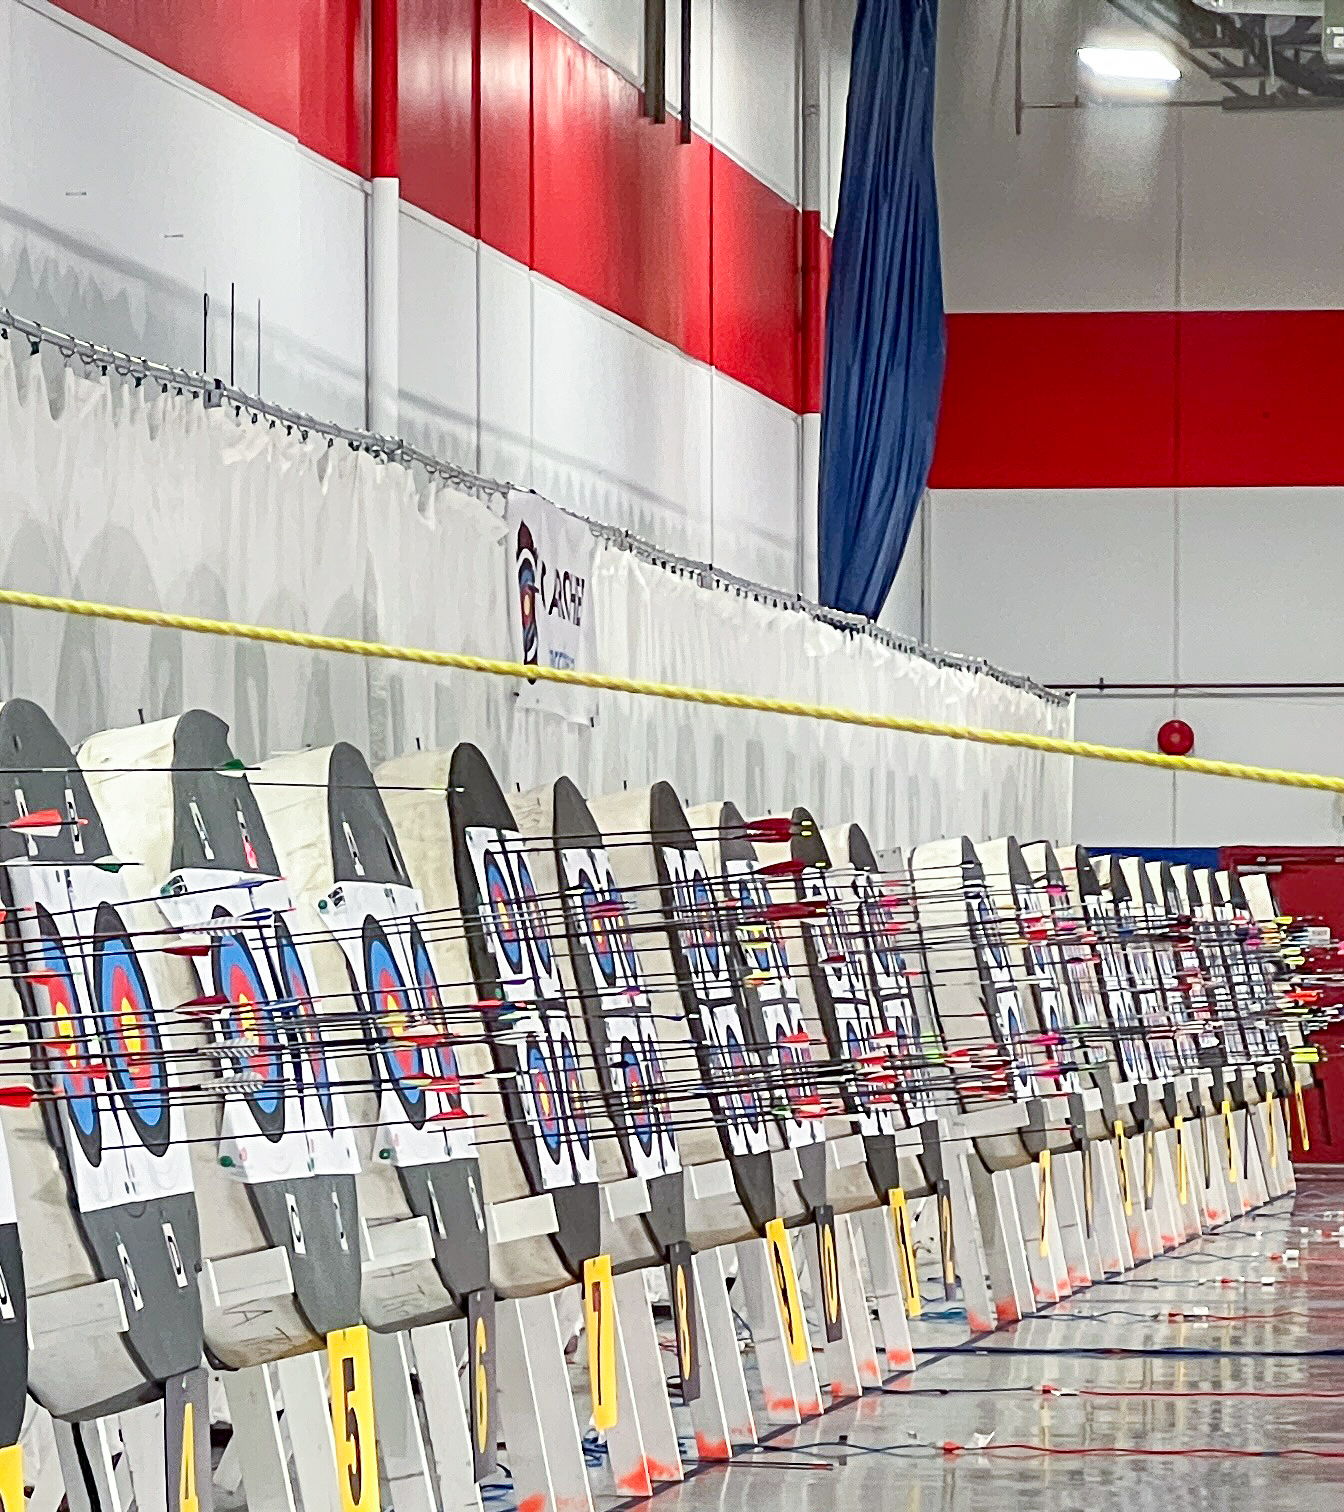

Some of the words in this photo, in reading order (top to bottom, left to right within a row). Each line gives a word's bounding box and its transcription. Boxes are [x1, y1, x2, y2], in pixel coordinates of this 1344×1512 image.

[475, 1316, 489, 1454] 6
[591, 1281, 603, 1407] 7
[675, 1264, 692, 1381] 8
[341, 1356, 362, 1506] 5
